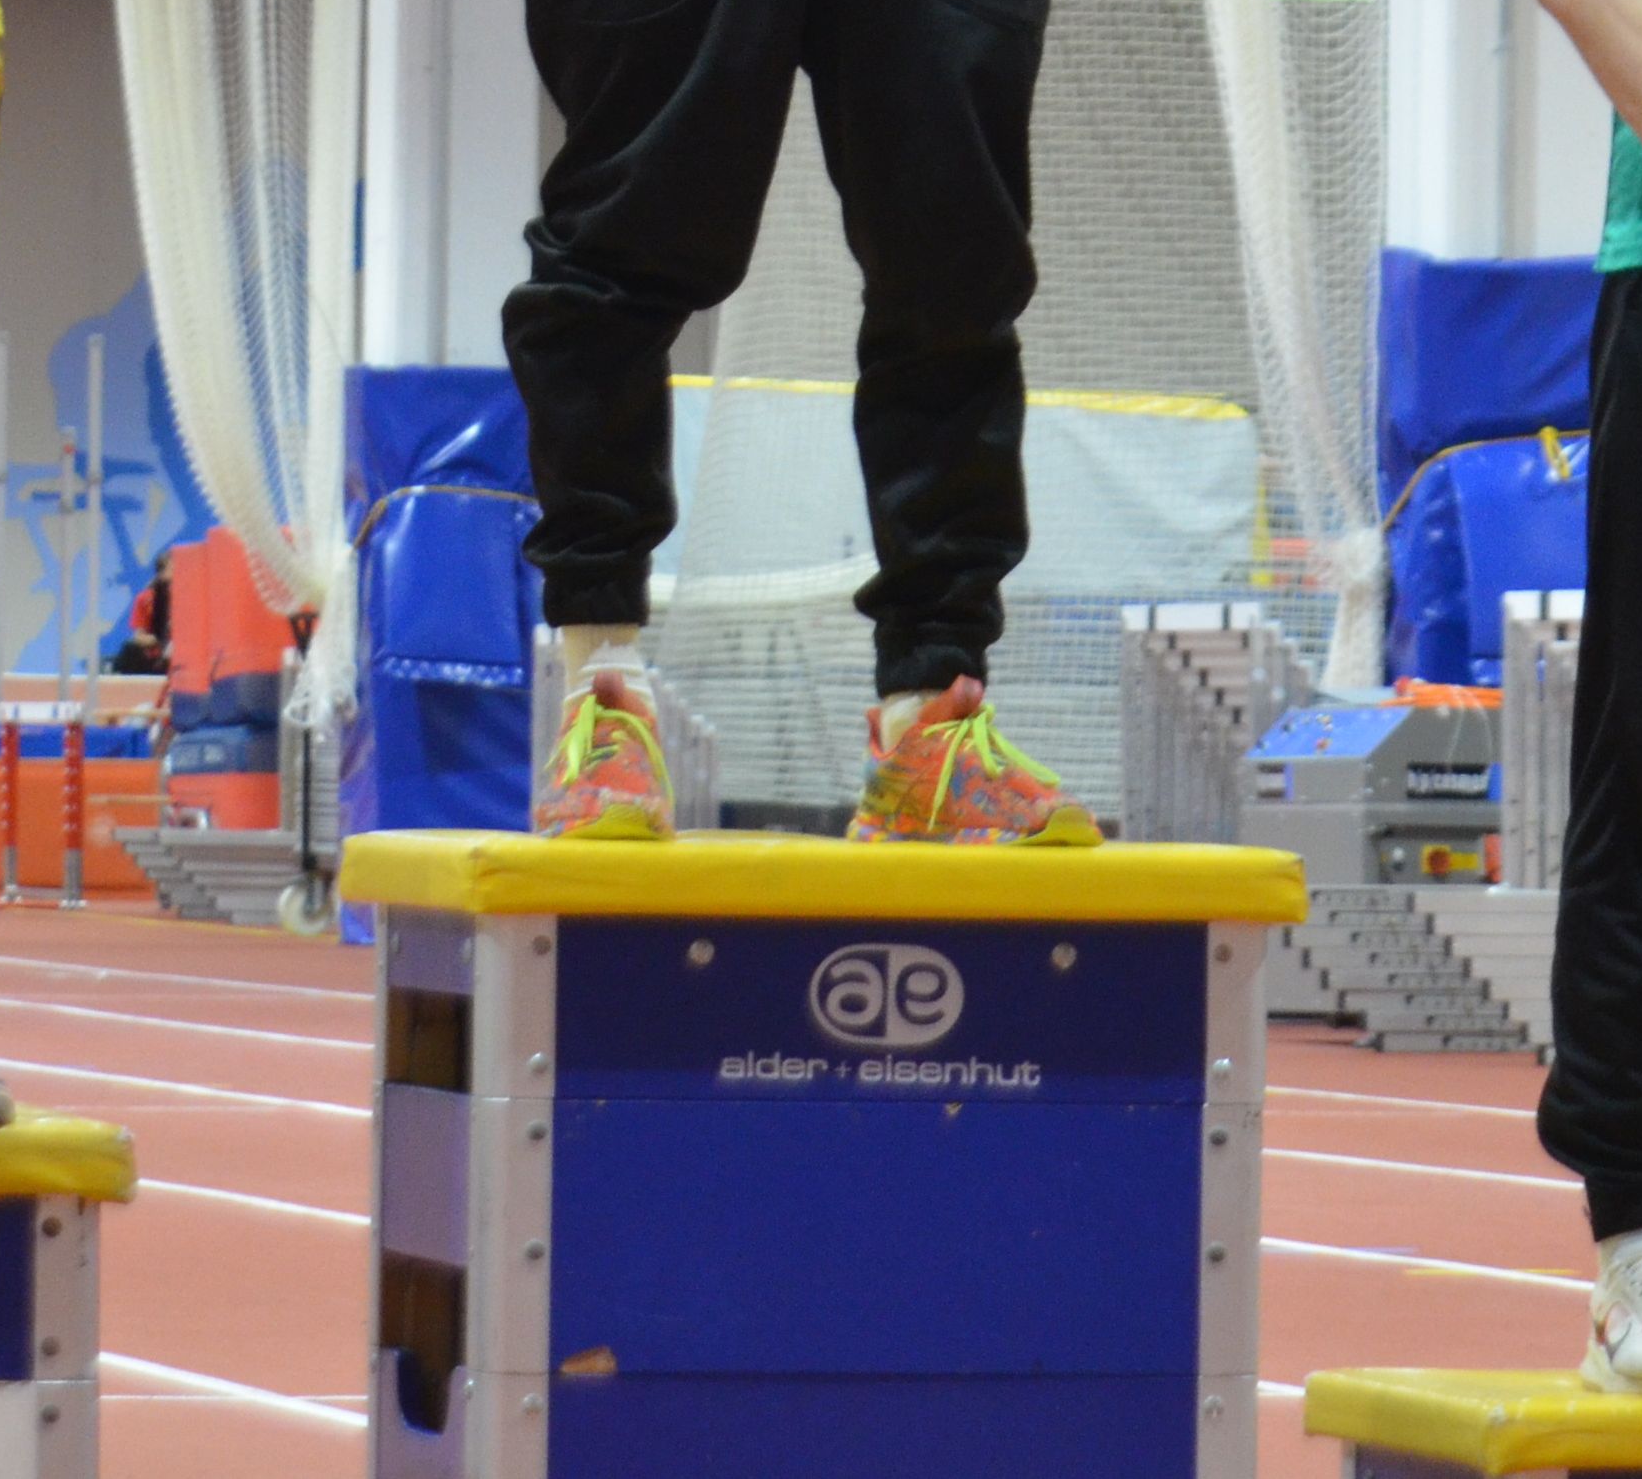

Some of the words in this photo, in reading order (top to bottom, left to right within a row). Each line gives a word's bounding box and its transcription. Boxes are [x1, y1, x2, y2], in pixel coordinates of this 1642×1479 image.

[720, 1051, 829, 1080] alder
[834, 1061, 852, 1078] +
[859, 1054, 1042, 1087] eisenhut
